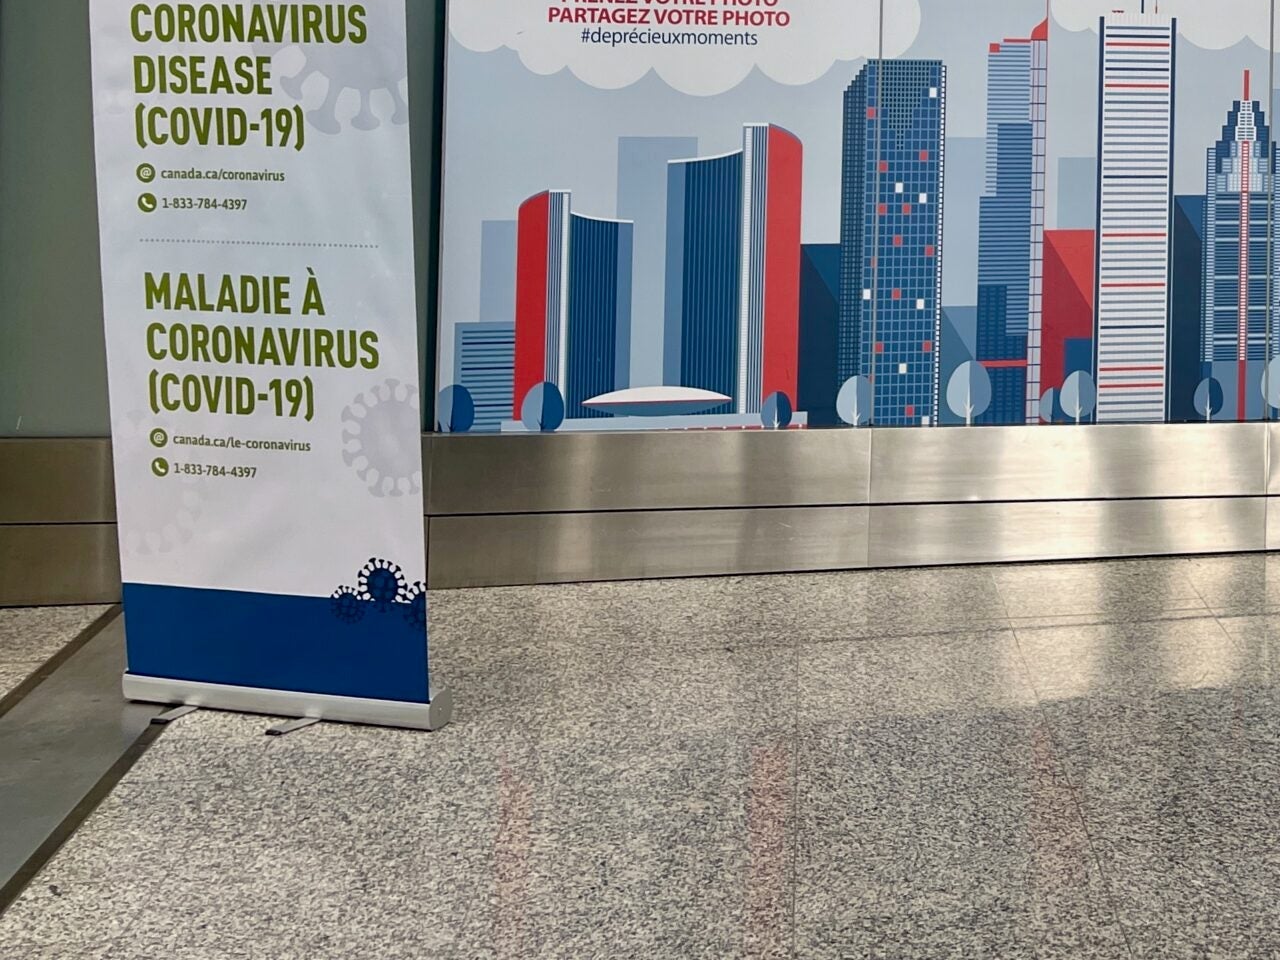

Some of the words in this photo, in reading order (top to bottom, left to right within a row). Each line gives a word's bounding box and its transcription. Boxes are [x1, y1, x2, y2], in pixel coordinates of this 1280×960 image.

[131, 4, 367, 44] CORONAVIRUS
[549, 7, 650, 24] PARTAGEZ
[654, 9, 718, 25] VOTRE
[723, 10, 790, 26] PHOTO
[581, 28, 758, 47] #deprécieuxmoments
[134, 56, 272, 95] DISEASE
[135, 103, 304, 151] (COVID-19)
[161, 168, 285, 181] canada.ca/coronavirus
[163, 198, 247, 210] 1-833-784-4397
[145, 272, 291, 314] MALADIE
[302, 267, 325, 315] À
[147, 323, 379, 369] CORONAVIRUS
[149, 369, 314, 422] (COVID-19)
[173, 435, 311, 451] canada.ca/le-coronavirus
[175, 463, 256, 478] 1-833-784-4397
